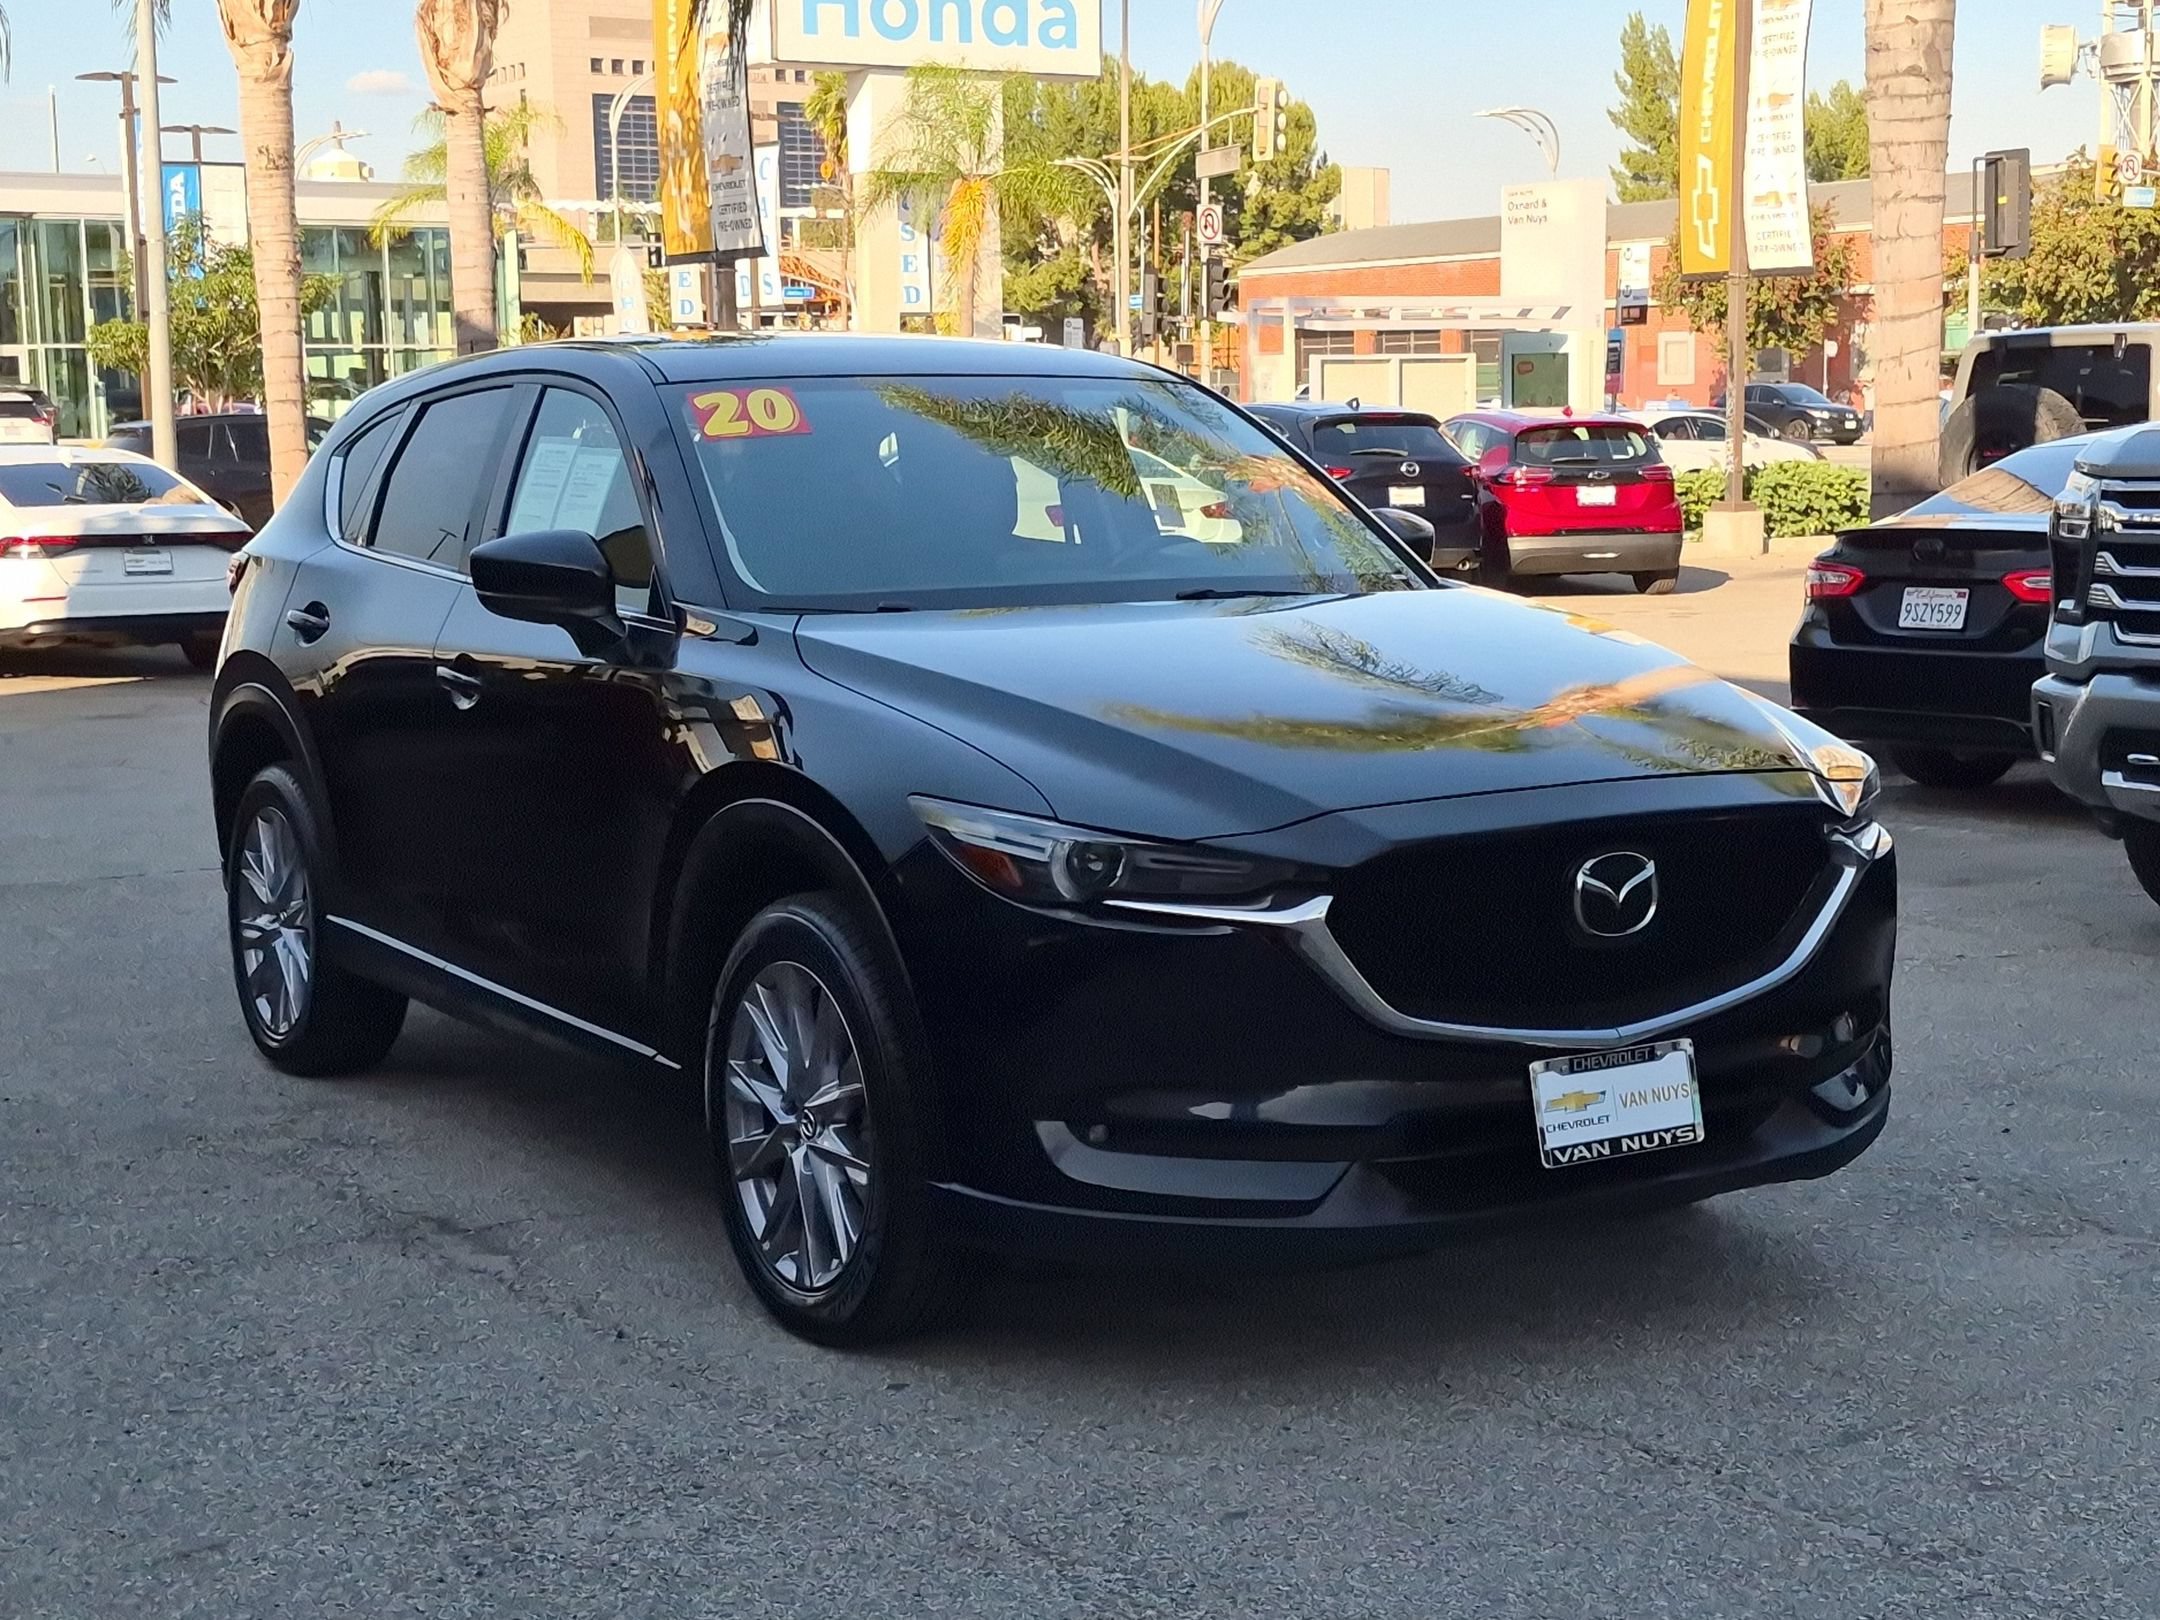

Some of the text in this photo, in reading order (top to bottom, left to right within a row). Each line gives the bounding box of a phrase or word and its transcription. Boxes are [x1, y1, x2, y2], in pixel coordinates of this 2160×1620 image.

[712, 179, 746, 192] CHEVROLET
[1508, 198, 1547, 212] Oxnard &
[1508, 214, 1548, 225] Van Nuys
[1756, 230, 1801, 241] CERTIFIE
[693, 388, 800, 437] 20
[1903, 603, 1962, 623] 9SZY599
[1573, 1049, 1650, 1072] CHEVROLET
[1619, 1082, 1690, 1109] VAN NUYS
[1546, 1115, 1610, 1134] CHEVROLET
[1553, 1126, 1696, 1164] VAN NUYS
